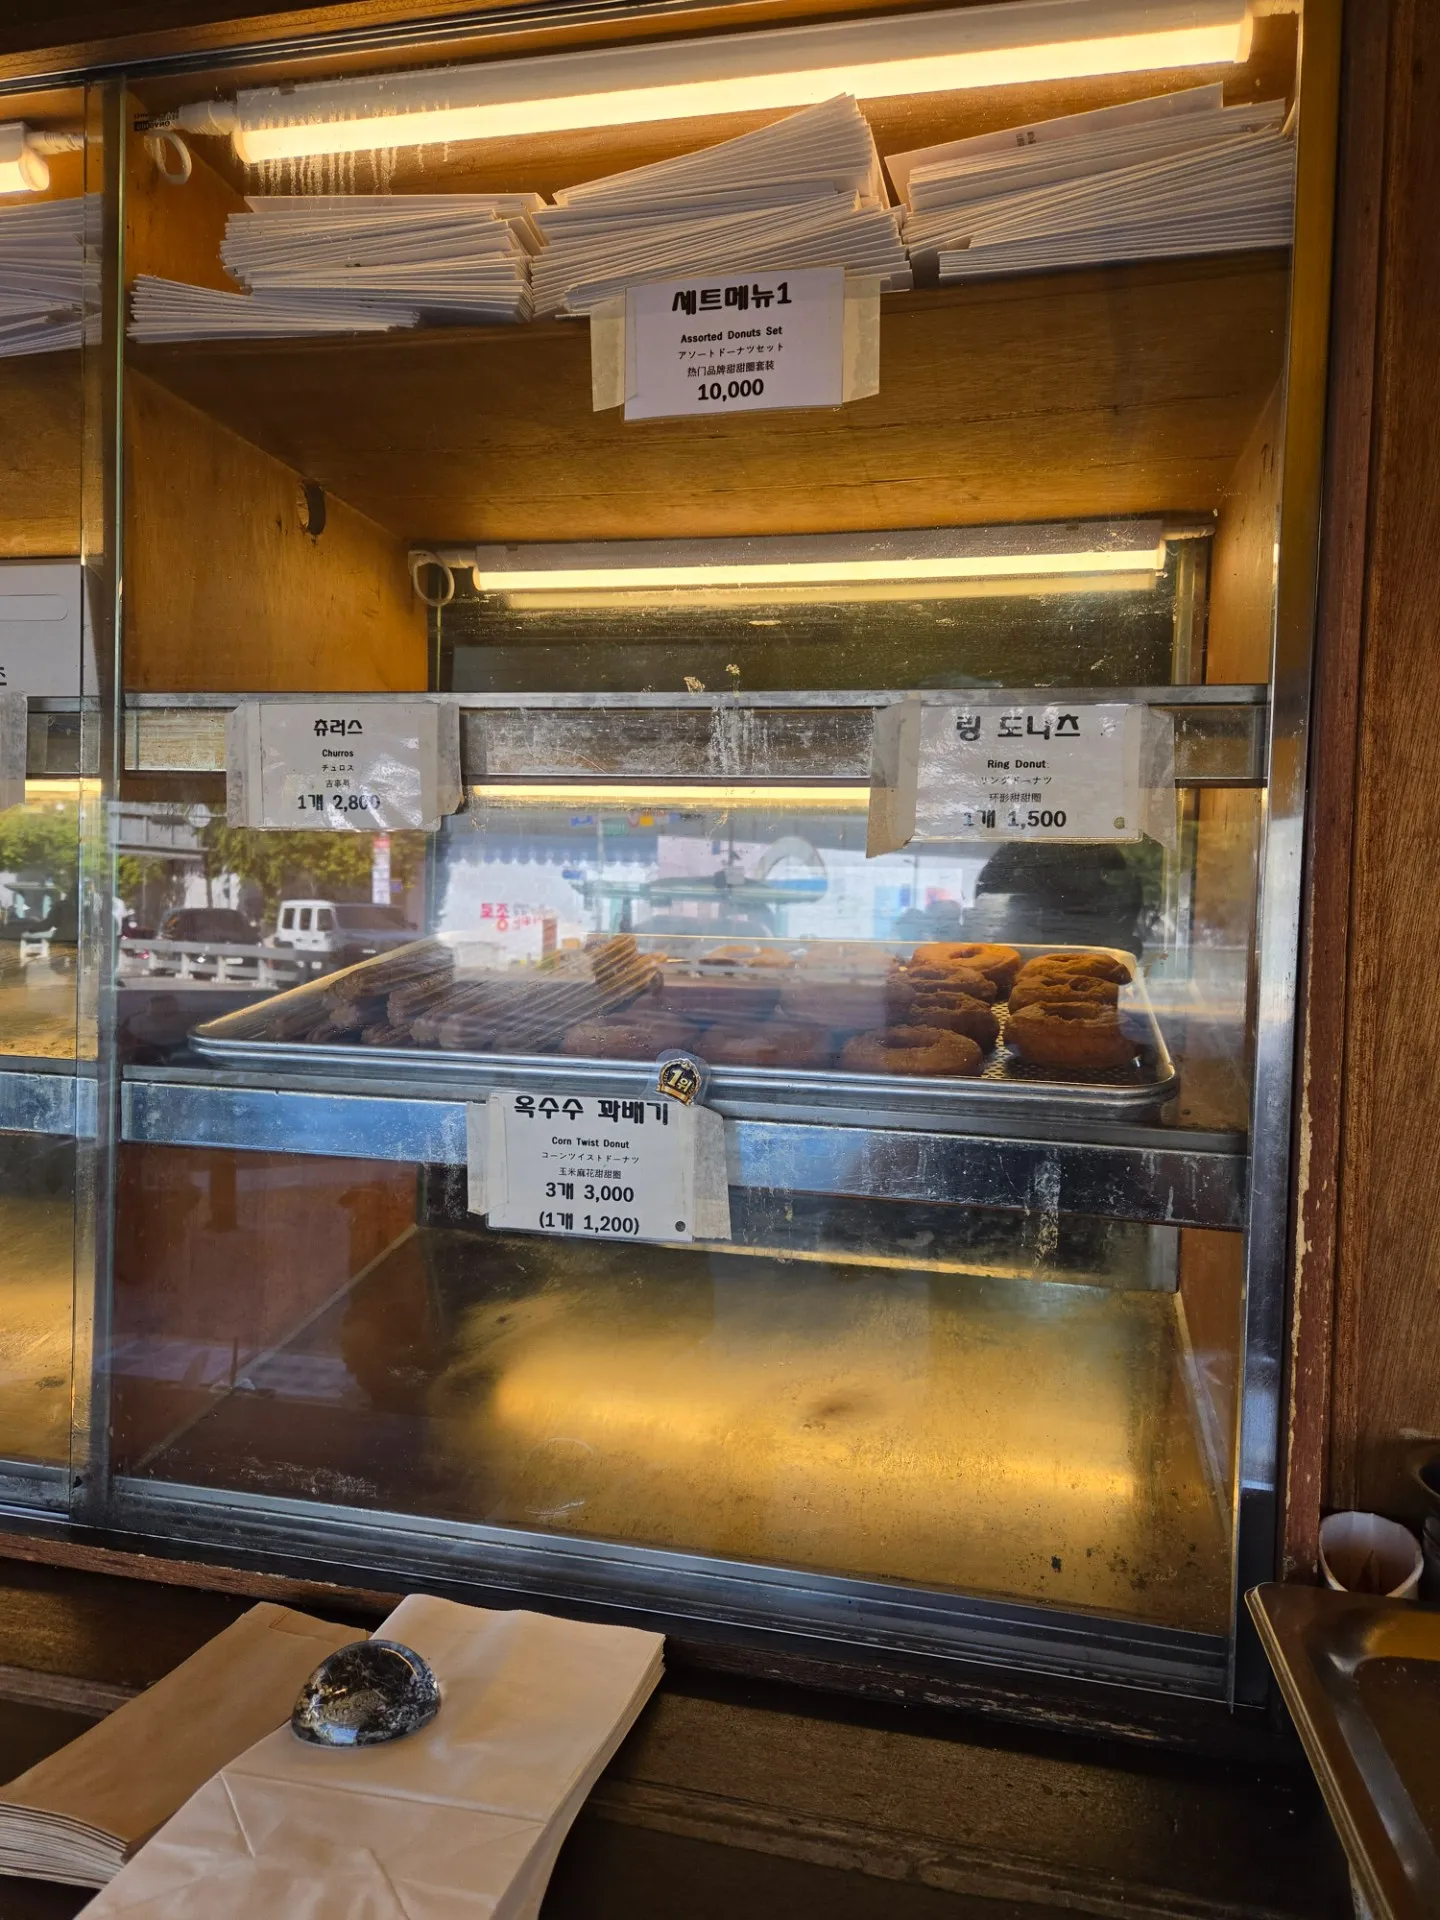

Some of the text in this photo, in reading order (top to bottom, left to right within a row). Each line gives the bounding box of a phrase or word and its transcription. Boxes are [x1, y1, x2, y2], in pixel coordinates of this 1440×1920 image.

[672, 282, 792, 315] 세트메뉴1
[680, 326, 783, 344] Assorted Donuts Set
[698, 379, 764, 401] 10,000
[314, 719, 362, 736] 츄러스
[956, 716, 980, 741] 링
[321, 748, 354, 758] Churros
[321, 764, 354, 773] チュロス
[987, 759, 1046, 770] Ring Donut
[298, 794, 380, 812] 1개 2,800
[964, 810, 1066, 829] 1개 1,500
[667, 1069, 693, 1092] 1위
[514, 1095, 669, 1125] 옥수수 꽈배기
[551, 1136, 630, 1149] Corn Twist Donut
[546, 1182, 634, 1202] 3개 3,000
[539, 1211, 640, 1236] (1개 1,200)
